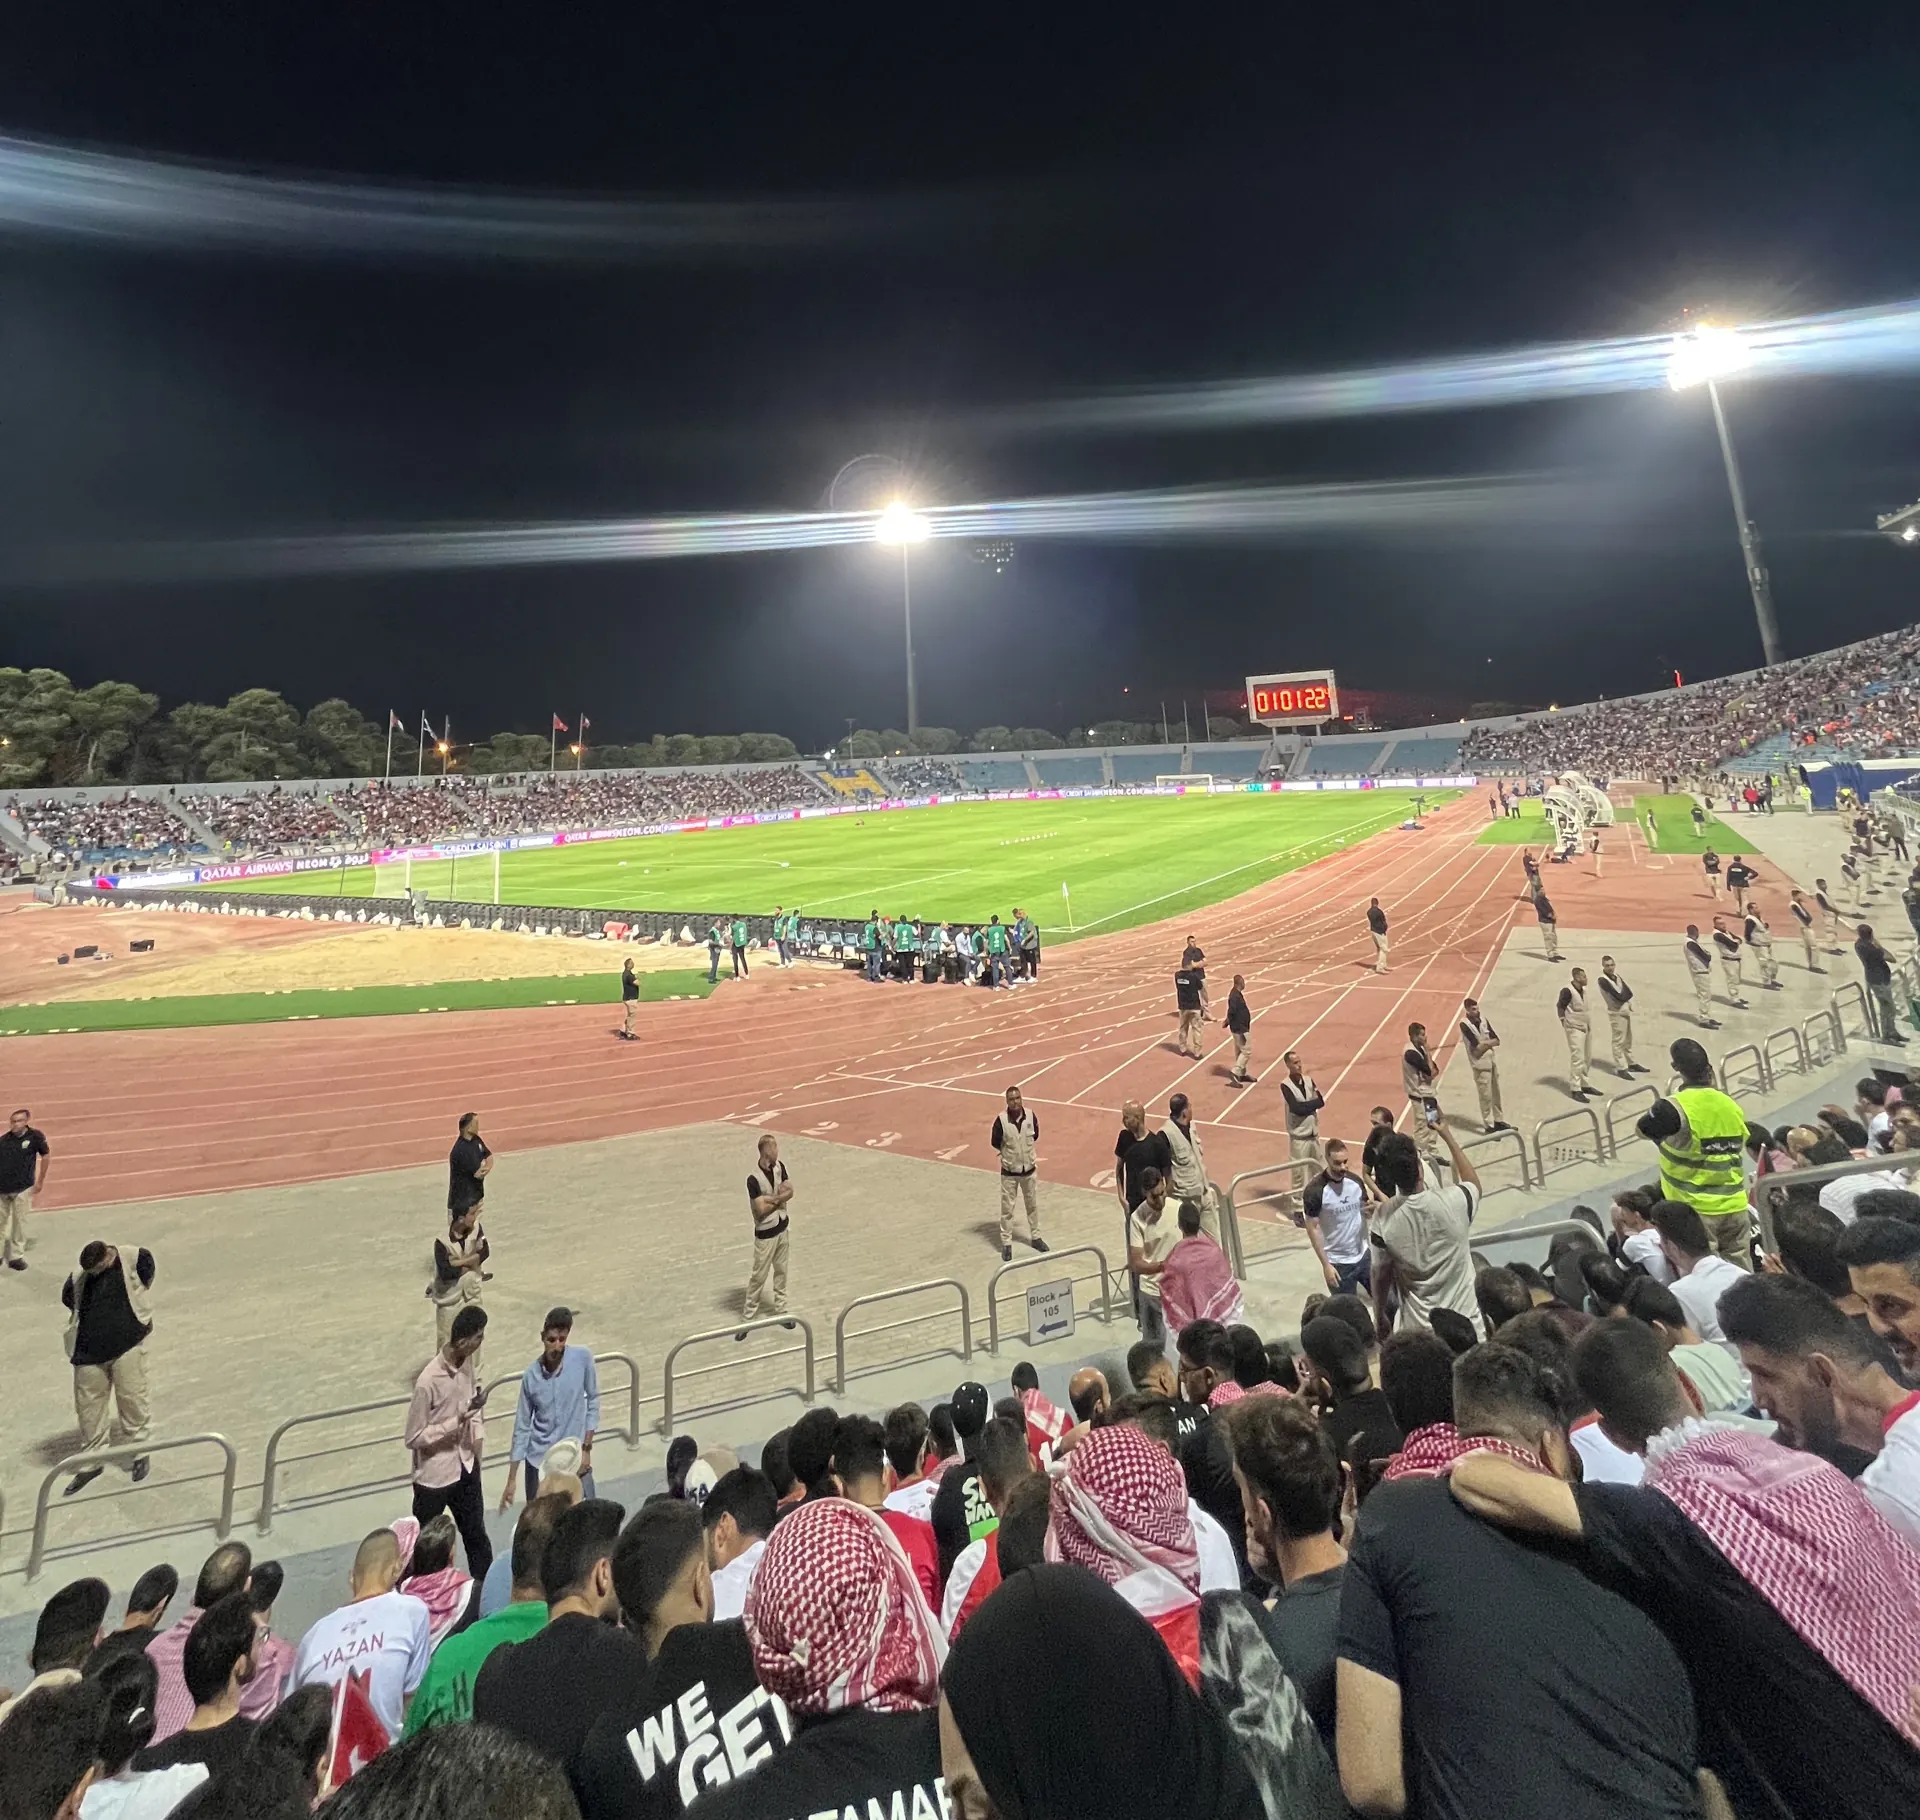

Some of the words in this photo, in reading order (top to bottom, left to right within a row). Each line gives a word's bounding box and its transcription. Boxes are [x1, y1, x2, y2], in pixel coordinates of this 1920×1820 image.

[201, 866, 241, 882] QATAR
[244, 859, 292, 876] AIRWAYS
[296, 858, 328, 870] NEOM
[1029, 1292, 1056, 1306] Block
[1043, 1305, 1060, 1318] 105
[322, 1631, 385, 1671] YAZAN
[626, 1680, 716, 1784] WE
